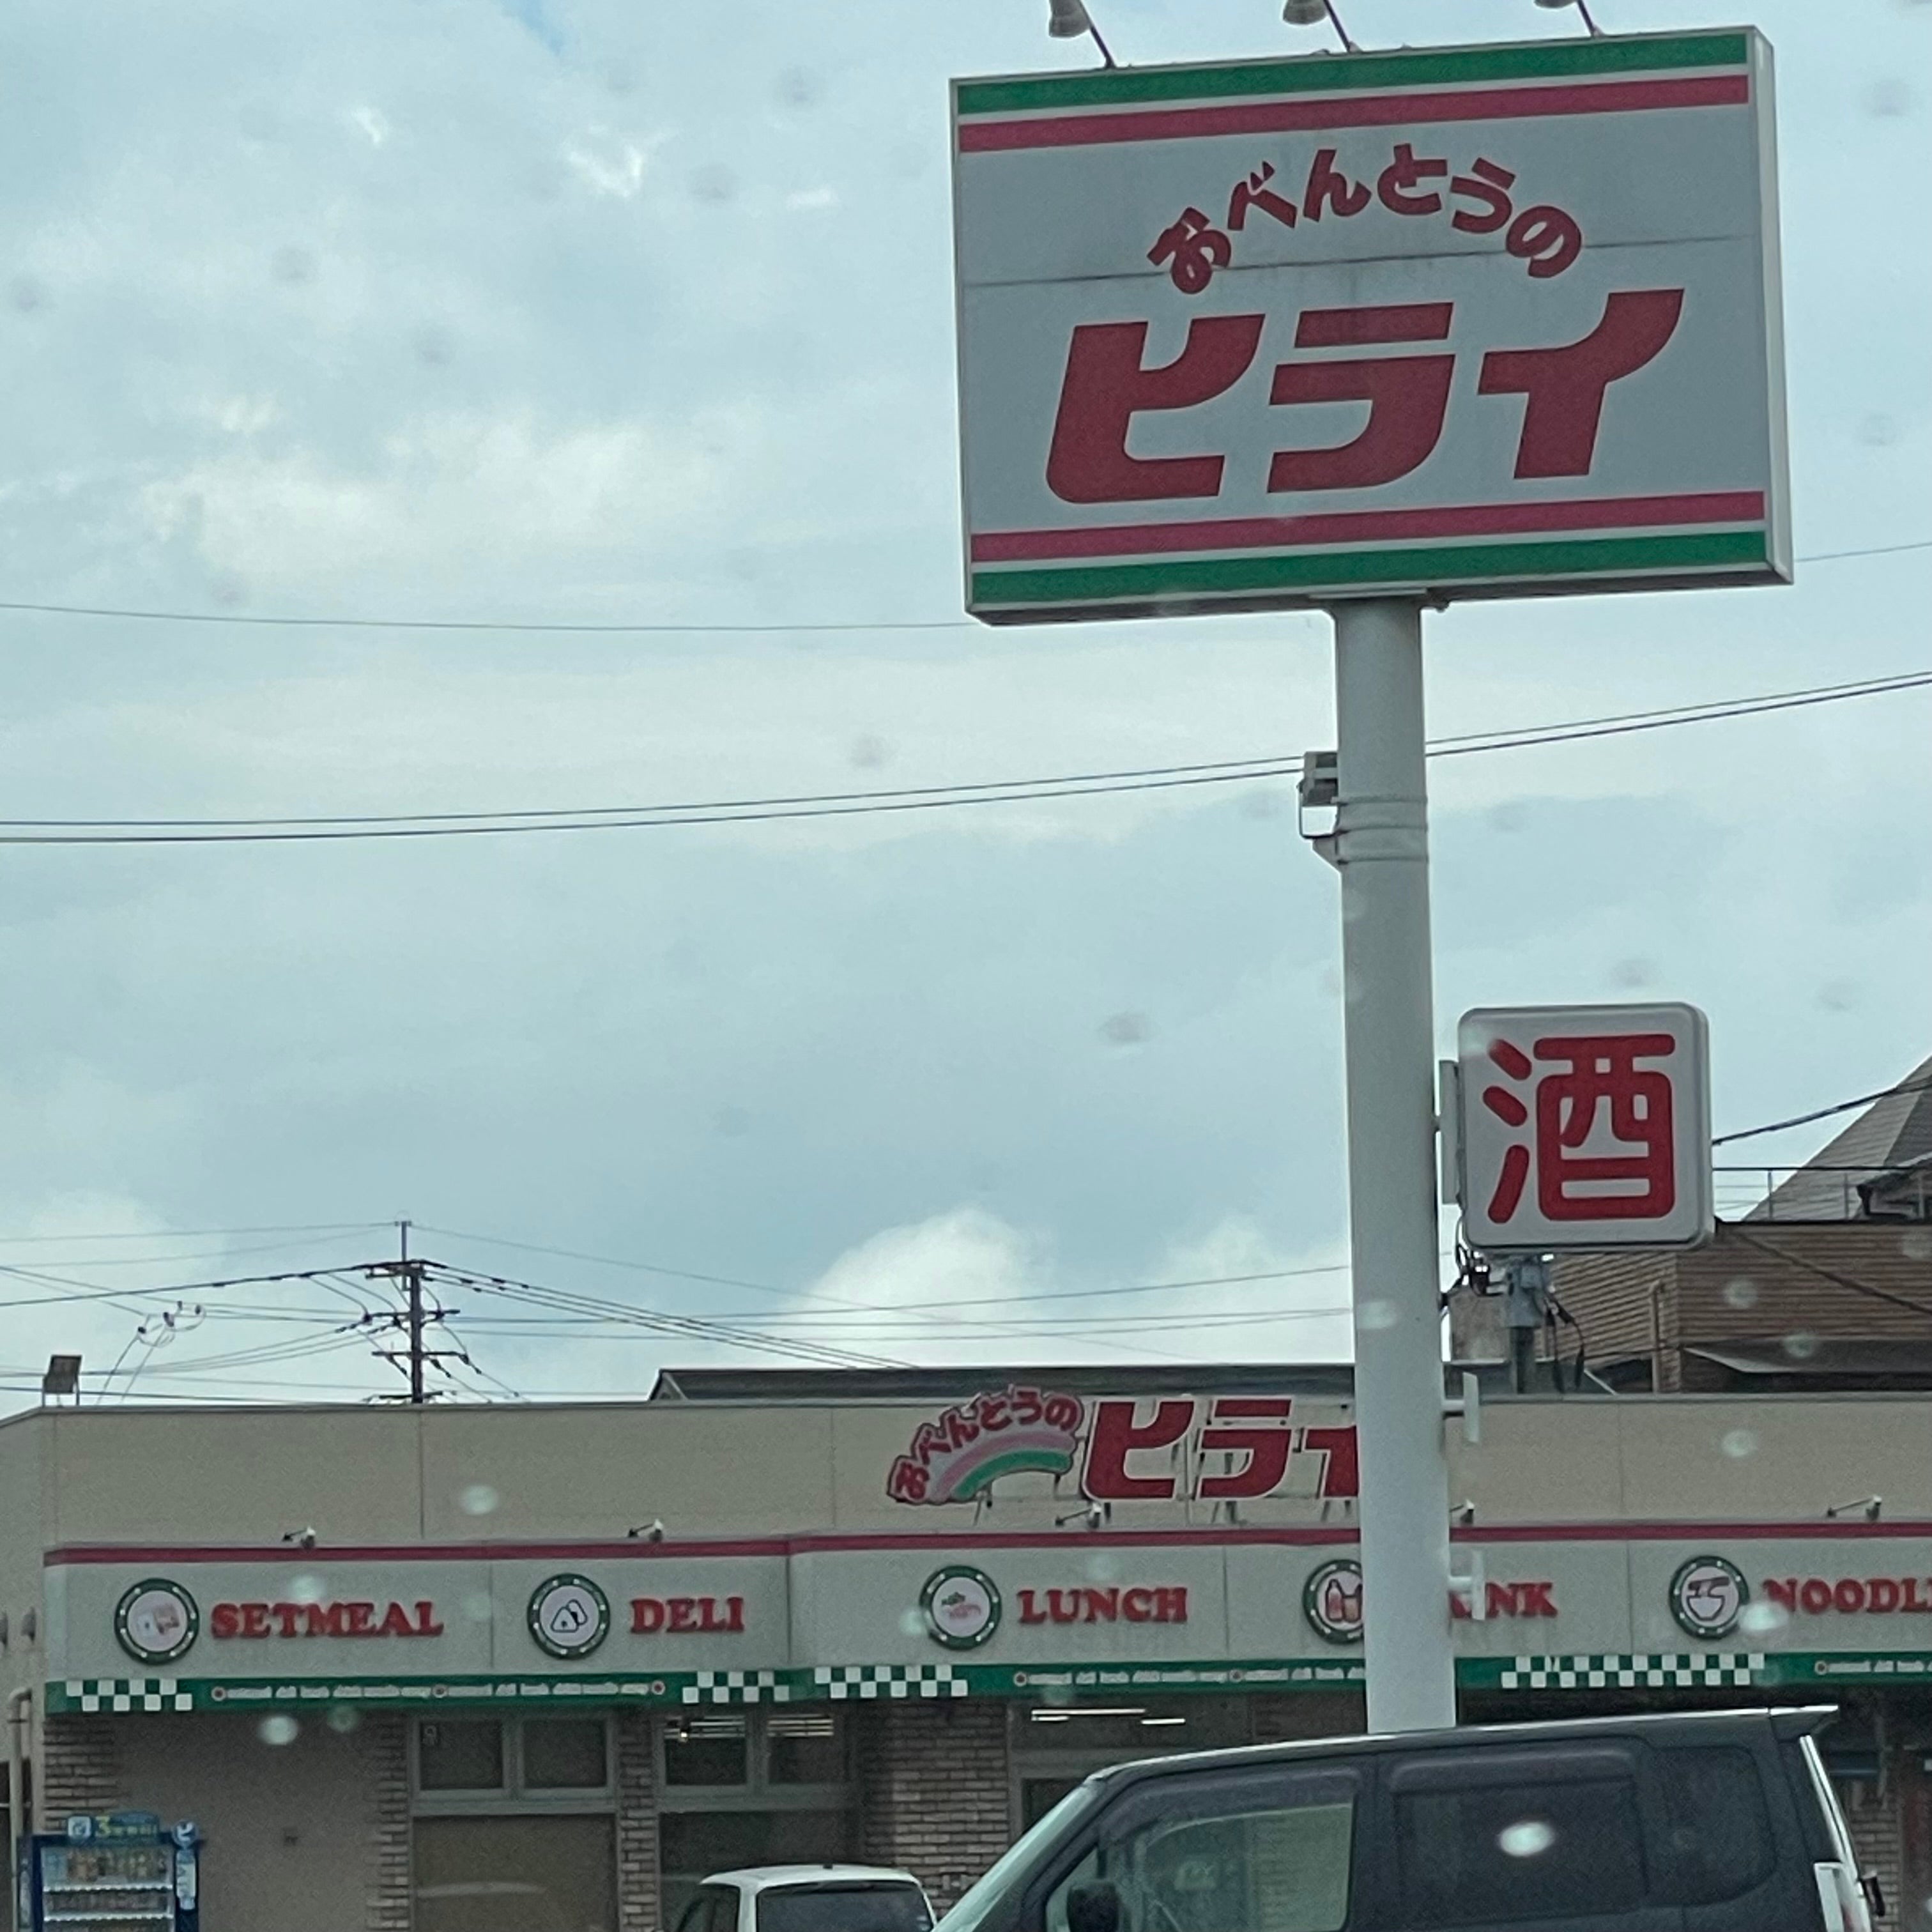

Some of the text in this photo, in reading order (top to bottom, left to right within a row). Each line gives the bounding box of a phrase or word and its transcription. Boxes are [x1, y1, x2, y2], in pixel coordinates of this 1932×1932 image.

[1147, 142, 1582, 295] おべんとうの
[1046, 288, 1685, 504] ヒライ
[1482, 1034, 1675, 1224] 酒
[894, 1391, 1080, 1499] おべんとうの
[211, 1602, 445, 1639] SETMEAL
[630, 1597, 744, 1633] DELI
[1017, 1587, 1188, 1625] LUNCH
[1763, 1577, 1932, 1614] NOODL
